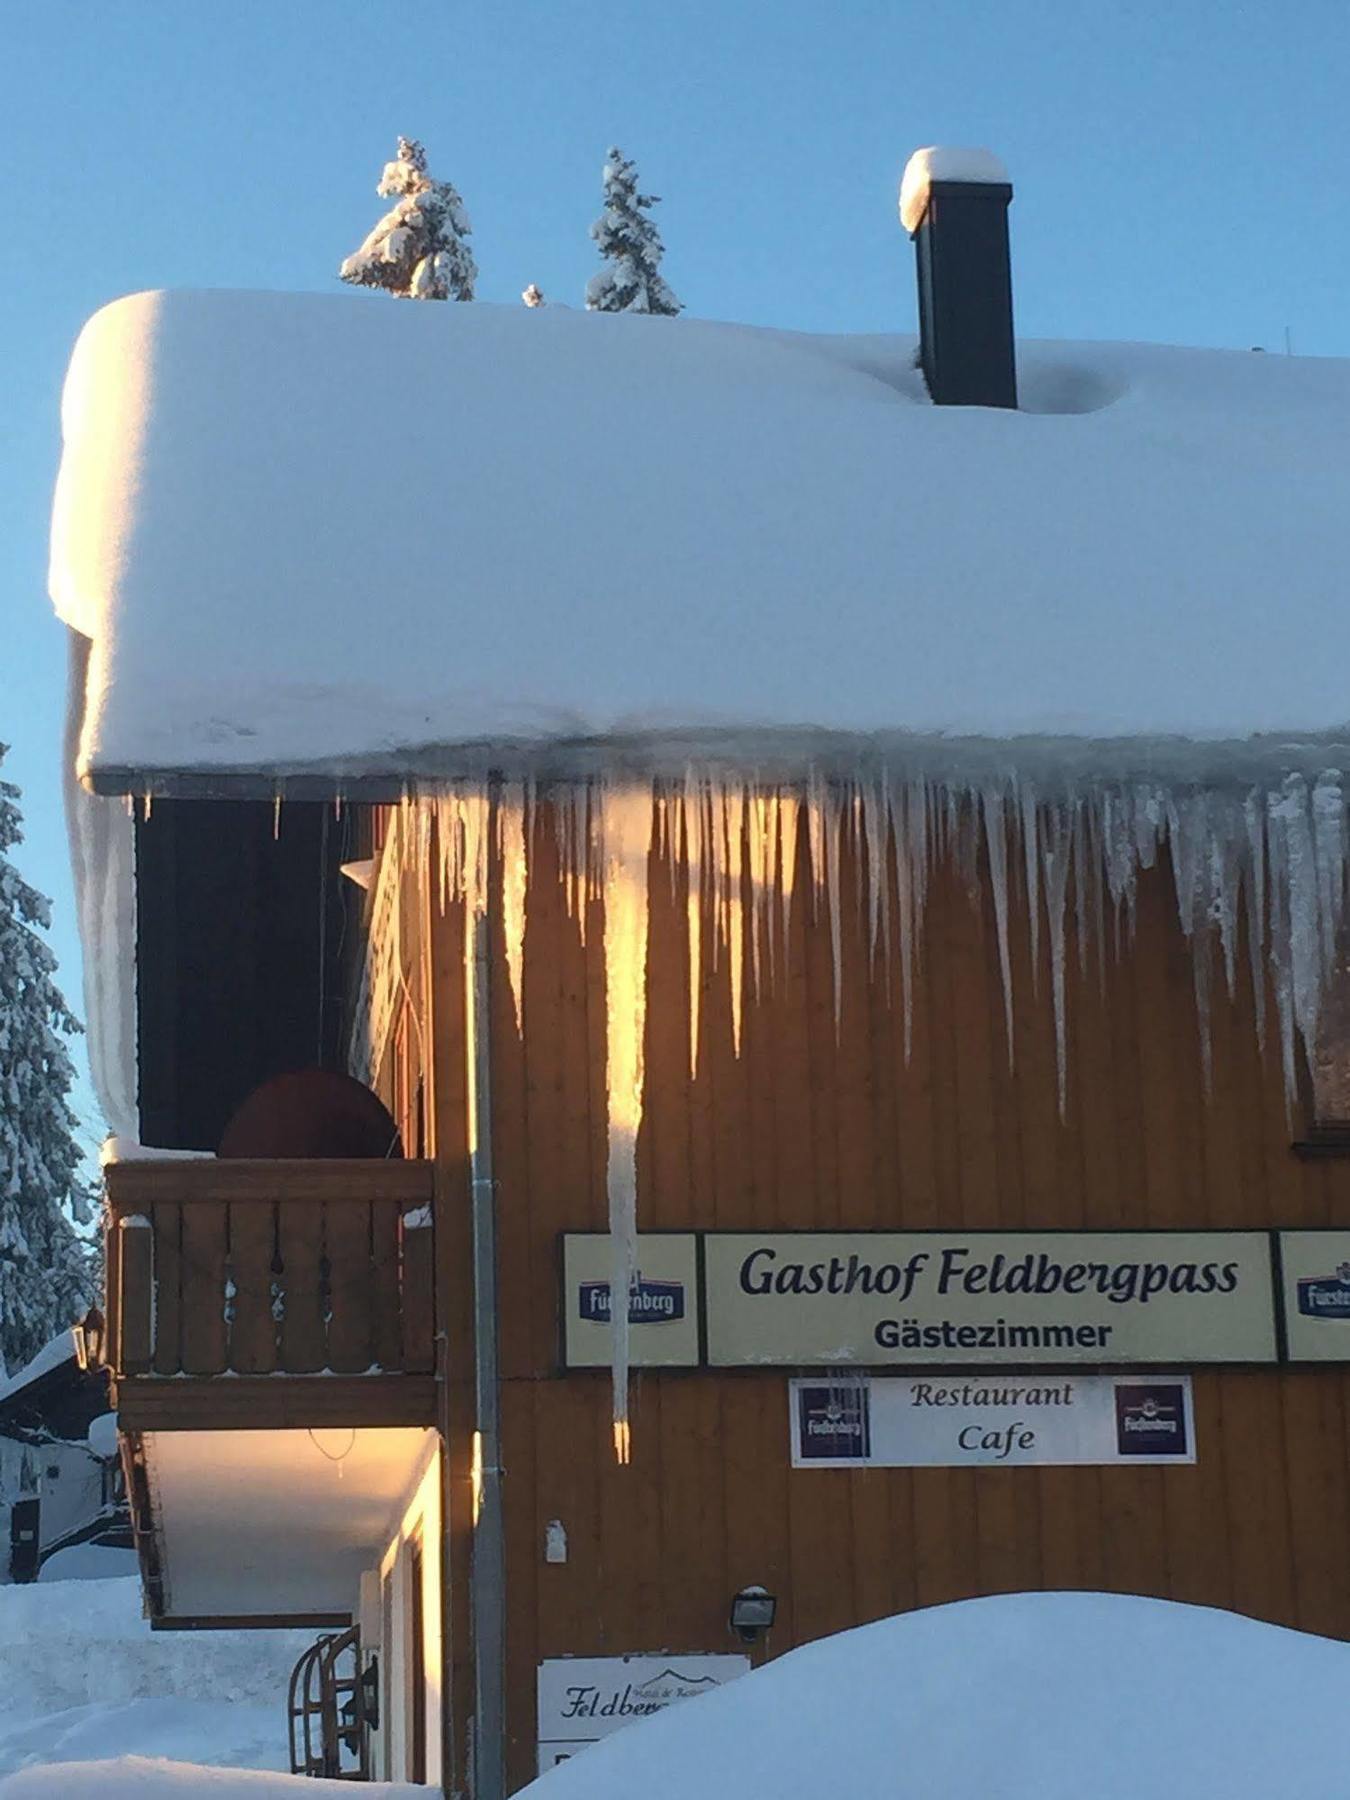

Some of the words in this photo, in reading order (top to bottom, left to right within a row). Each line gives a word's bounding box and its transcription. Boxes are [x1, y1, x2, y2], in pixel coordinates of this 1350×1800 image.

[739, 1247, 930, 1302] Gasthof
[937, 1247, 1239, 1303] Feldbergpass
[873, 1318, 1113, 1349] Gästezimmer
[910, 1383, 1074, 1407] Restaurant
[957, 1422, 1036, 1459] Cafe
[561, 1683, 670, 1718] Feldber
